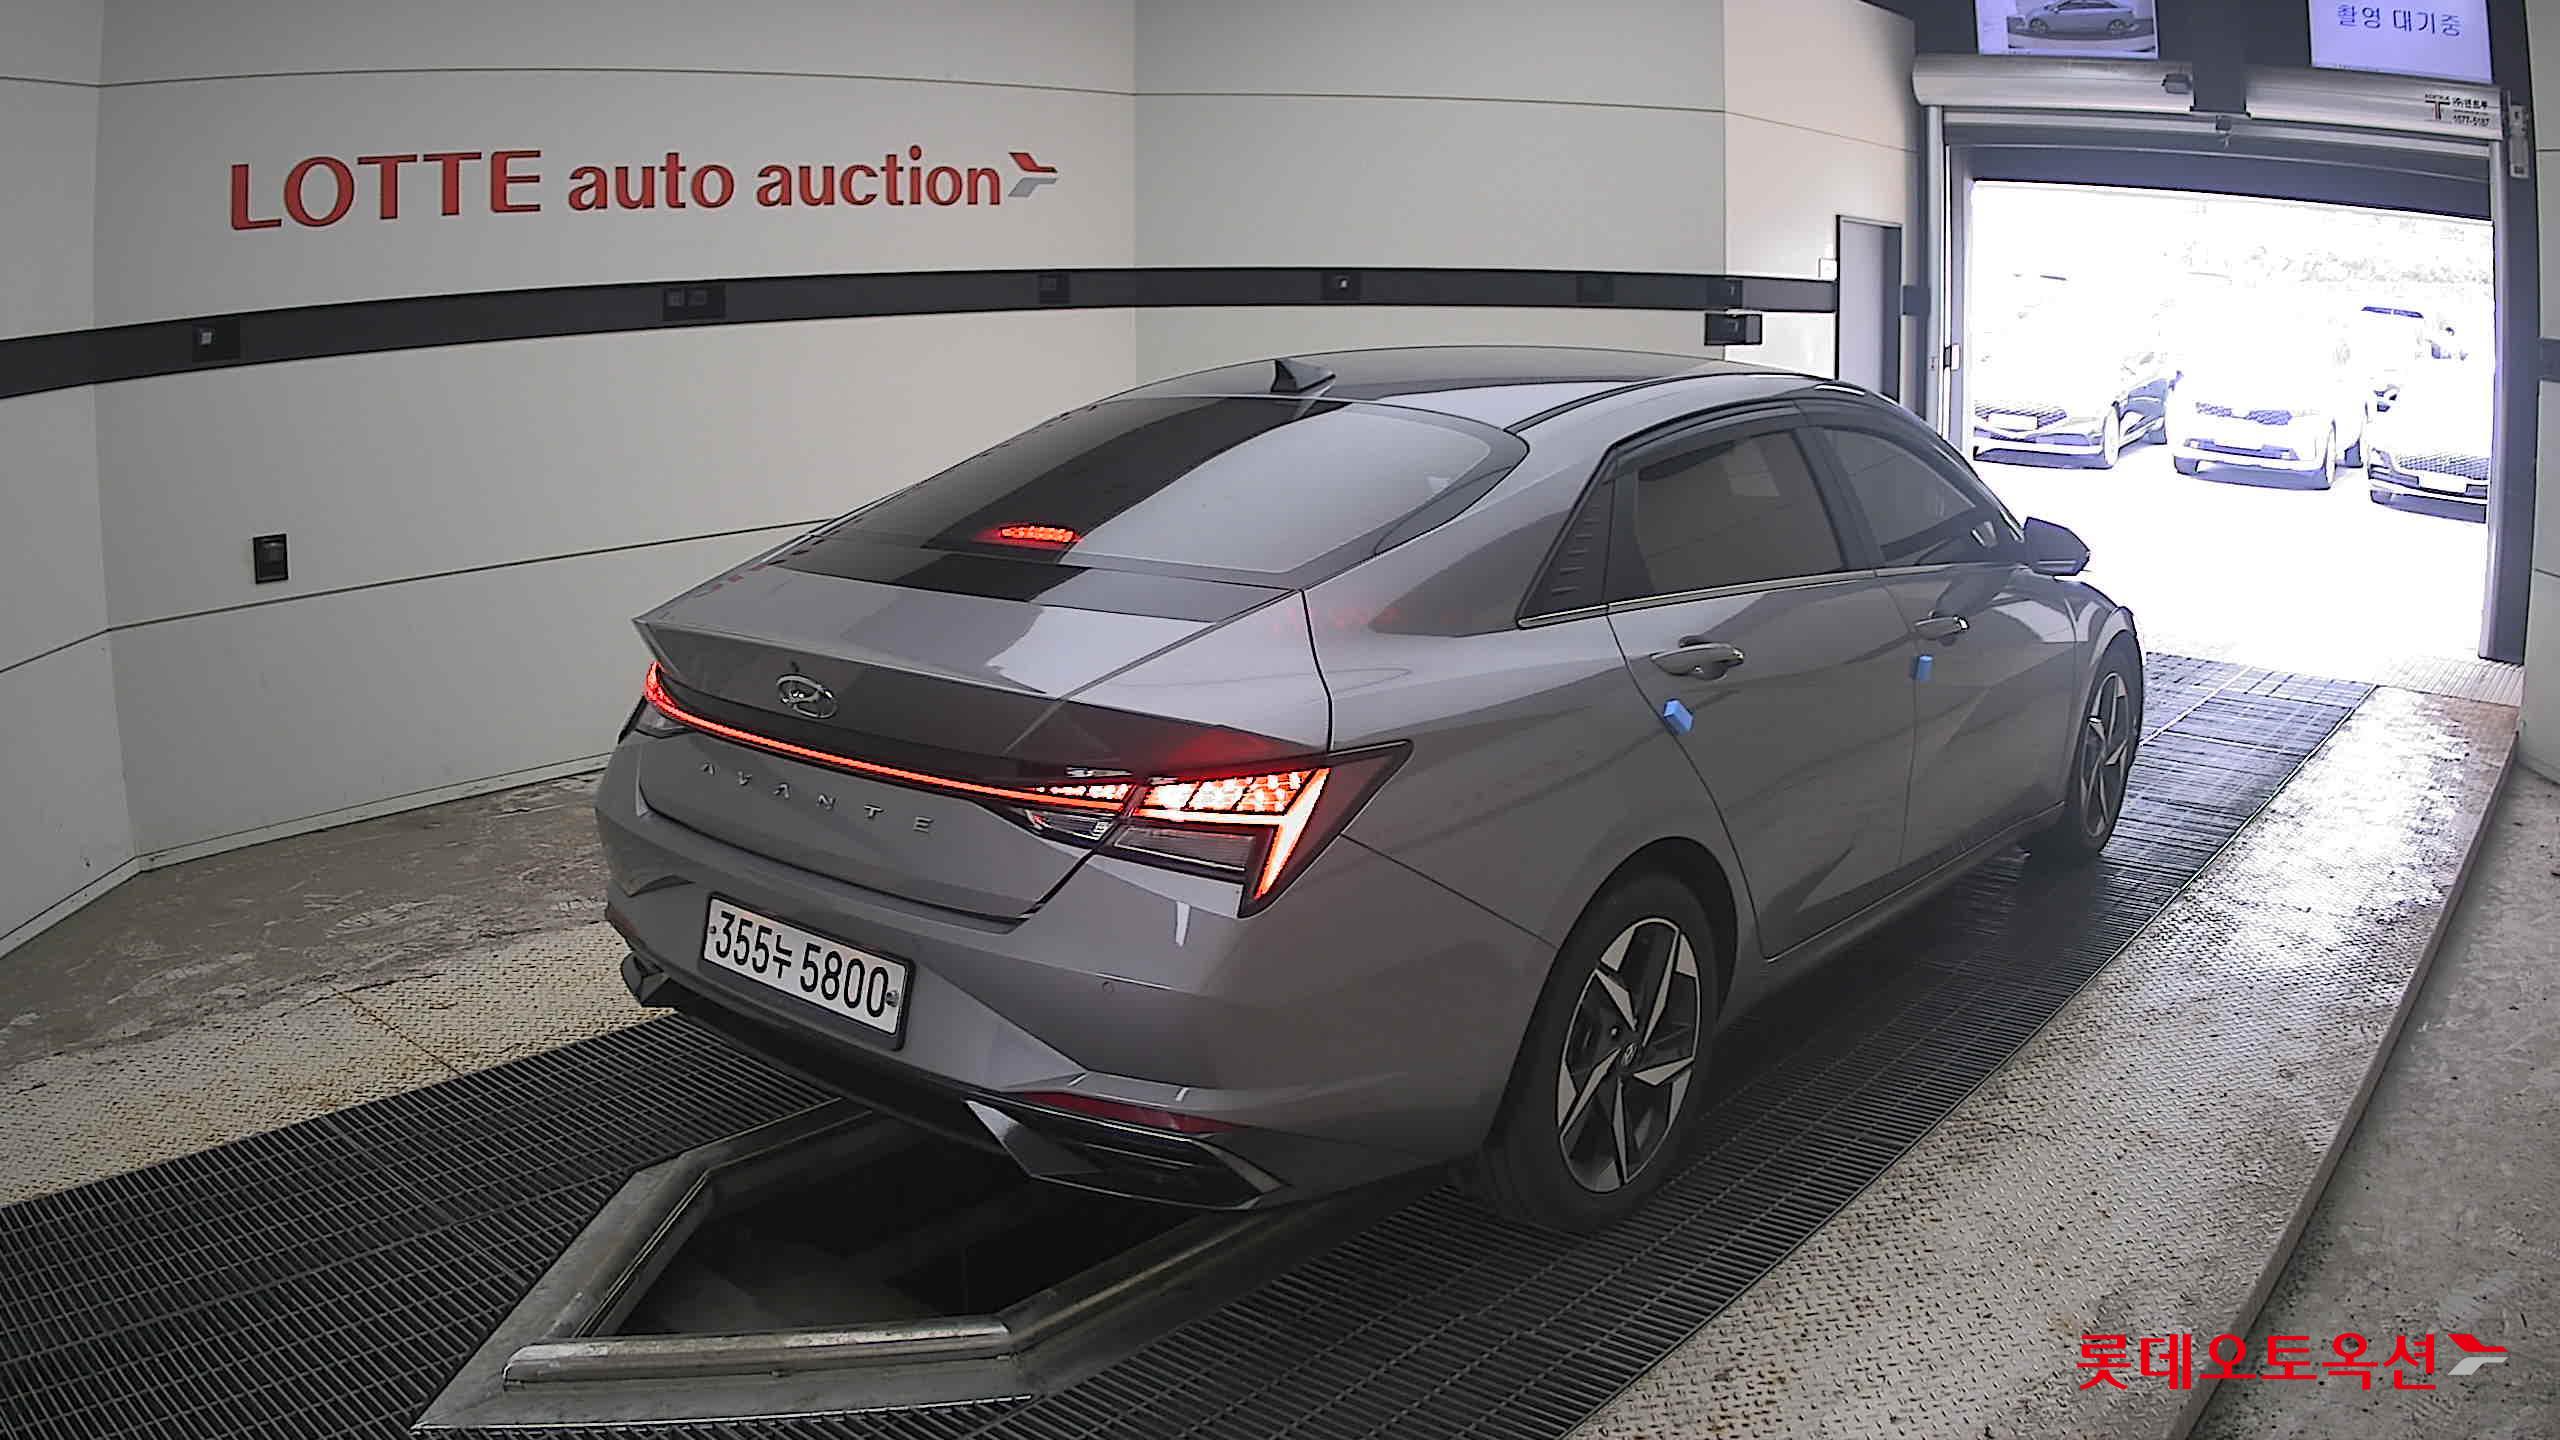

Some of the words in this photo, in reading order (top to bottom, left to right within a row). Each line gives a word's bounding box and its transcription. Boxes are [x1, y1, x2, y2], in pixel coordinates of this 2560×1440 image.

[2337, 4, 2382, 30] 촬영
[2392, 9, 2461, 38] 대기중
[231, 150, 542, 231] LOTTE
[567, 151, 736, 211] auto
[755, 145, 1003, 207] auction
[701, 760, 934, 834] AVANTE
[714, 910, 793, 980] 355누
[799, 942, 890, 1019] 5800
